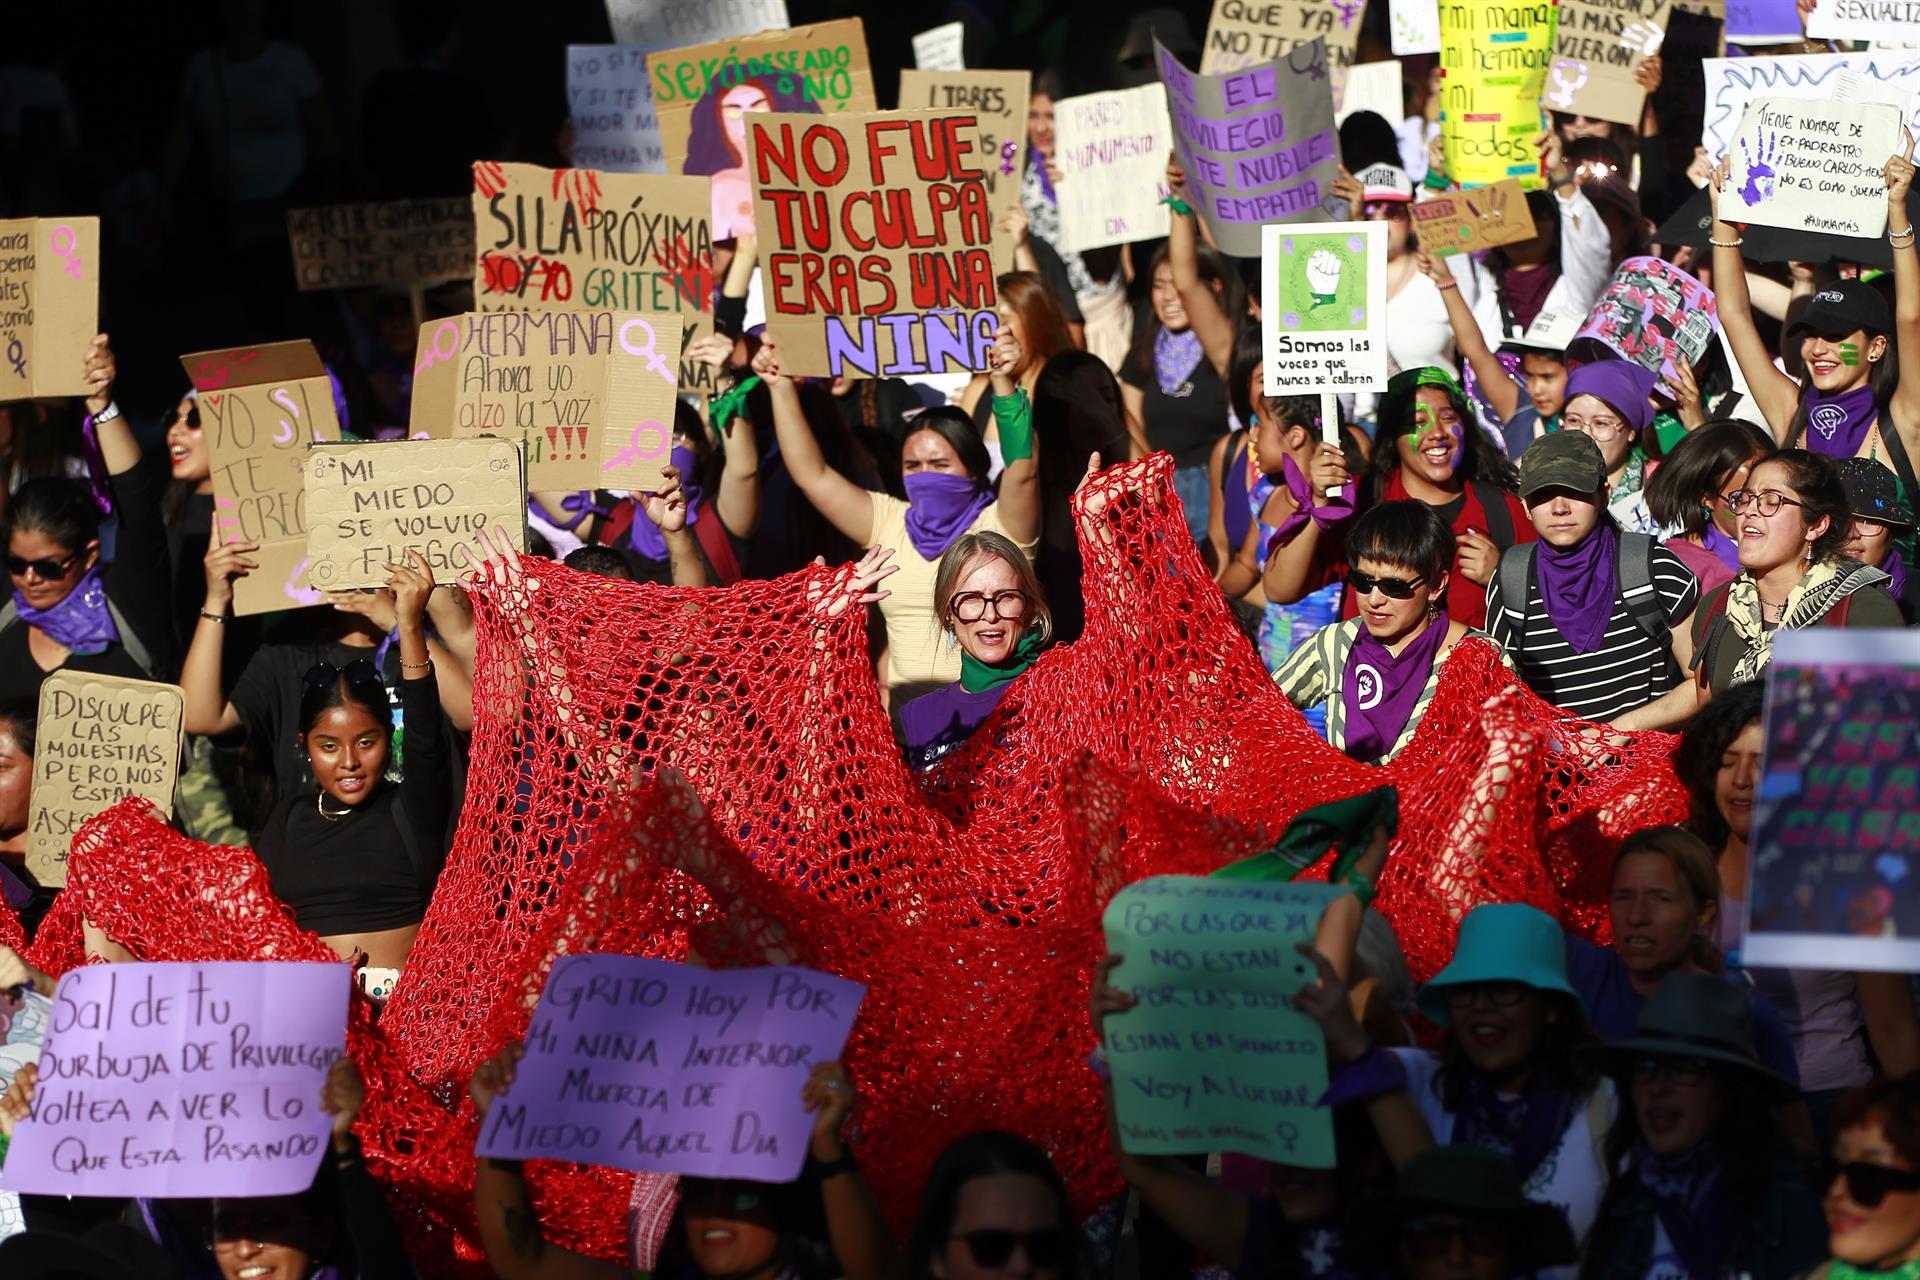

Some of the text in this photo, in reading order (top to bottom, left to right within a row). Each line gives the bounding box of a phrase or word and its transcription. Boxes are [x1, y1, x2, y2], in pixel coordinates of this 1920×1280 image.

[1221, 0, 1334, 33] QUE YA
[1449, 5, 1475, 31] mi
[749, 45, 850, 77] DESEADO
[1211, 29, 1355, 68] NO TIEEN
[1552, 34, 1635, 68] VIERON
[803, 68, 852, 103] NO
[1224, 73, 1274, 107] EL
[1450, 84, 1474, 112] mi
[1758, 102, 1794, 130] TIENE
[1850, 124, 1864, 138] DE
[752, 115, 985, 188] NO FUE
[1196, 156, 1227, 189] TE
[1238, 133, 1325, 188] NUBLE
[1779, 173, 1796, 187] NO
[1799, 177, 1814, 191] ES
[1819, 180, 1847, 195] COMO
[490, 192, 527, 250] SI
[536, 196, 583, 255] LA
[587, 195, 715, 271] PRÓXIMA
[759, 180, 992, 253] TU CULPA
[0, 232, 28, 250] ara
[480, 249, 573, 302] SOY YO
[582, 268, 705, 313] GRITEN
[769, 247, 997, 316] ERAS UNA
[462, 311, 614, 358] HERMANA
[823, 307, 1001, 378] NIÑA
[1279, 335, 1371, 354] Somos las
[463, 354, 574, 405] Ahora yo
[1277, 374, 1311, 386] nunca
[1315, 375, 1327, 385] se
[1278, 358, 1347, 375] voces que
[204, 383, 316, 450] YO SI
[459, 392, 593, 429] alzo la voz
[213, 455, 275, 498] TE
[354, 482, 455, 513] MIEDO
[338, 512, 488, 539] SE VOLVIO
[52, 689, 168, 730] DISCULPE
[71, 721, 122, 743] LAS
[45, 760, 164, 784] PERO NOS
[1124, 902, 1175, 937] POR
[1181, 911, 1226, 935] LAS
[1229, 910, 1275, 934] QUE
[1149, 947, 1282, 973] NO ESTAN
[54, 971, 116, 1034] Sal
[548, 957, 669, 1022] GRITO
[766, 970, 840, 1020] POR
[1132, 985, 1185, 1008] POR
[1191, 987, 1236, 1009] LAS
[182, 1040, 219, 1074] DE
[573, 1027, 661, 1069] NIÑA
[681, 1034, 816, 1071] INTERIOR
[1109, 1031, 1181, 1054] ESTAN
[1191, 1031, 1223, 1052] EN
[559, 1067, 729, 1114] MUERTA DE
[1201, 1073, 1225, 1096] A
[147, 1099, 170, 1122] A
[181, 1091, 243, 1122] VER
[121, 1136, 186, 1171] ESTA
[204, 1125, 321, 1163] PASANDO
[486, 1103, 781, 1159] MIEDO AQUEL DIA
